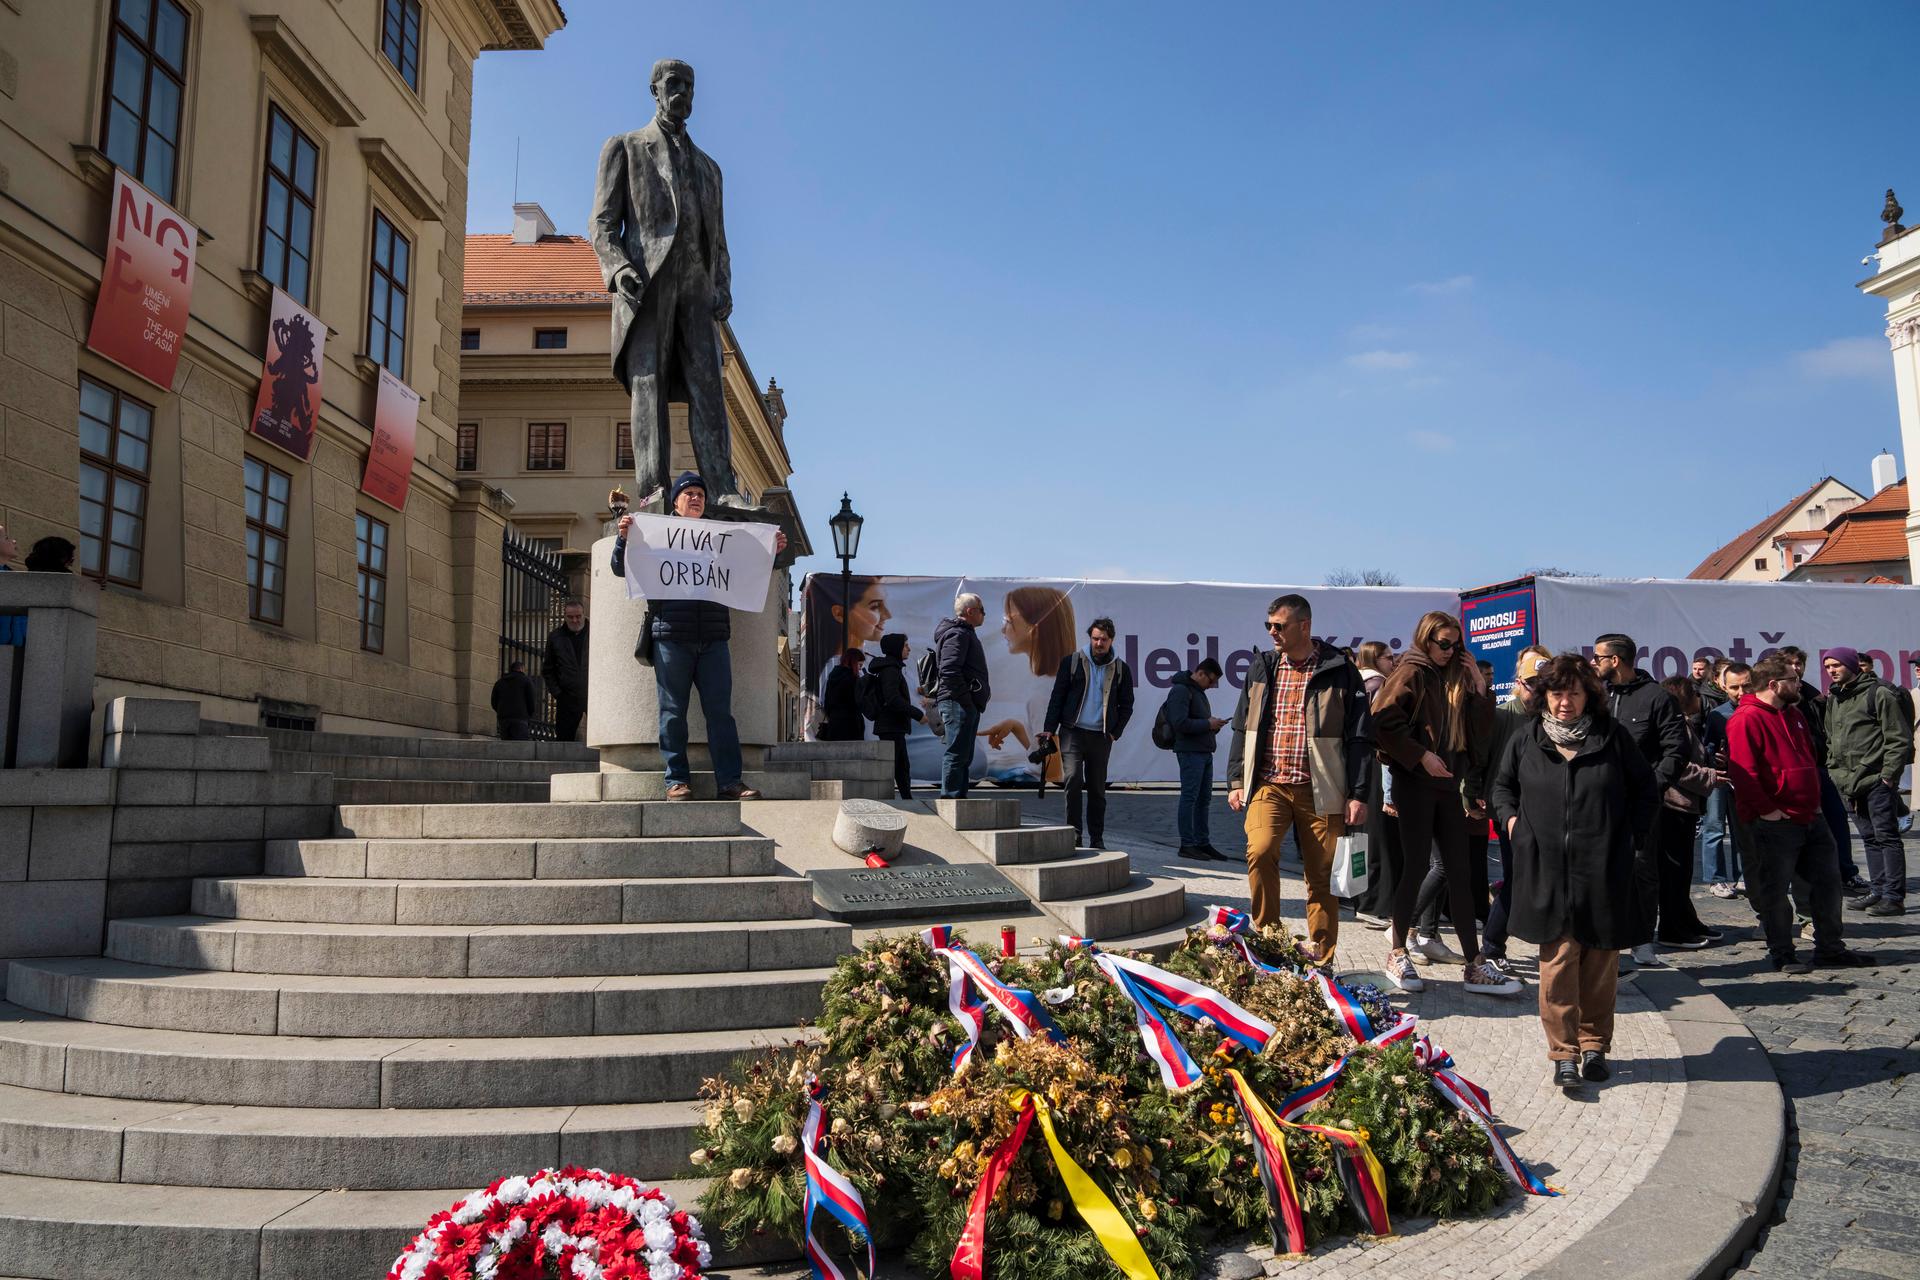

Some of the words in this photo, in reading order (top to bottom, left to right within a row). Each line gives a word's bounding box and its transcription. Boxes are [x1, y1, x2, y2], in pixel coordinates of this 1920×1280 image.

[142, 298, 161, 316] ASIE
[144, 284, 171, 308] UMĚNÍ
[143, 329, 155, 343] OF
[155, 335, 174, 354] ASIA
[146, 317, 163, 335] THE
[162, 325, 179, 345] ART
[667, 527, 733, 554] VIVAT
[659, 560, 730, 591] ORBÁN
[1470, 611, 1517, 632] NOPROSU
[1471, 631, 1504, 643] AUTODOPRAVA
[1504, 628, 1525, 638] SPEDICE
[1482, 638, 1512, 650] SKLADOVÁNÍ
